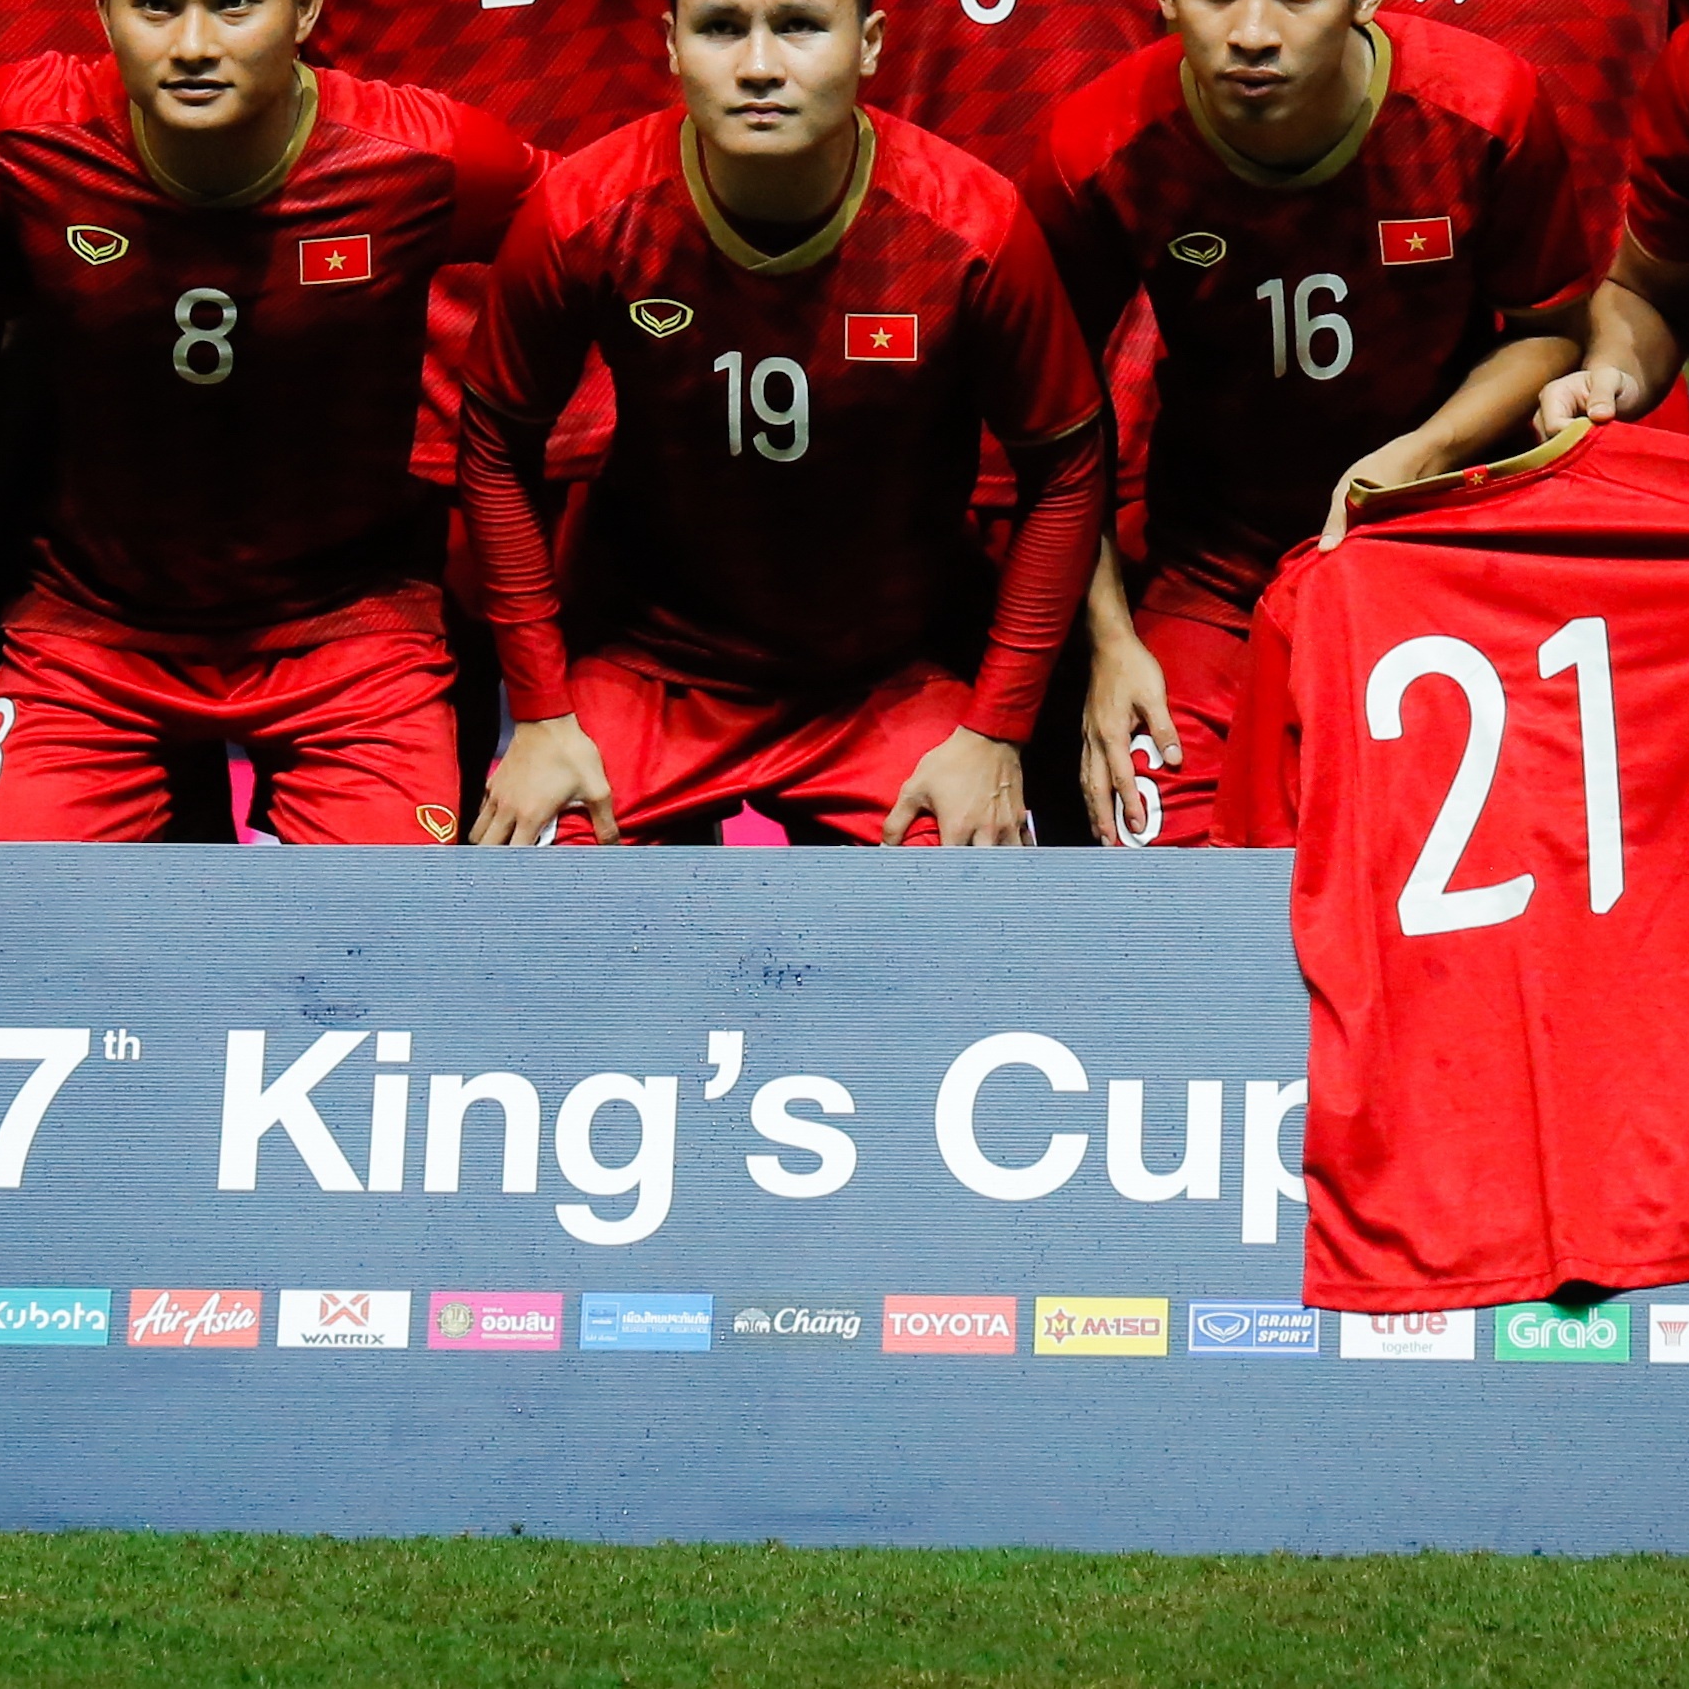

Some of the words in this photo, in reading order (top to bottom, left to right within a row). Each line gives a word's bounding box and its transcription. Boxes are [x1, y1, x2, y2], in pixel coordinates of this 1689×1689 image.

[172, 287, 238, 385] 8
[1256, 273, 1354, 381] 16
[713, 350, 810, 463] 19
[1364, 616, 1626, 938] 21
[218, 1028, 858, 1246] King’s
[300, 1333, 386, 1345] WARRIX
[773, 1308, 862, 1339] Chang
[888, 1313, 1010, 1336] TOYOTA
[1257, 1330, 1311, 1344] SPORT
[1258, 1314, 1312, 1328] GRAND
[1507, 1307, 1618, 1349] Grab
[1382, 1341, 1434, 1355] together
